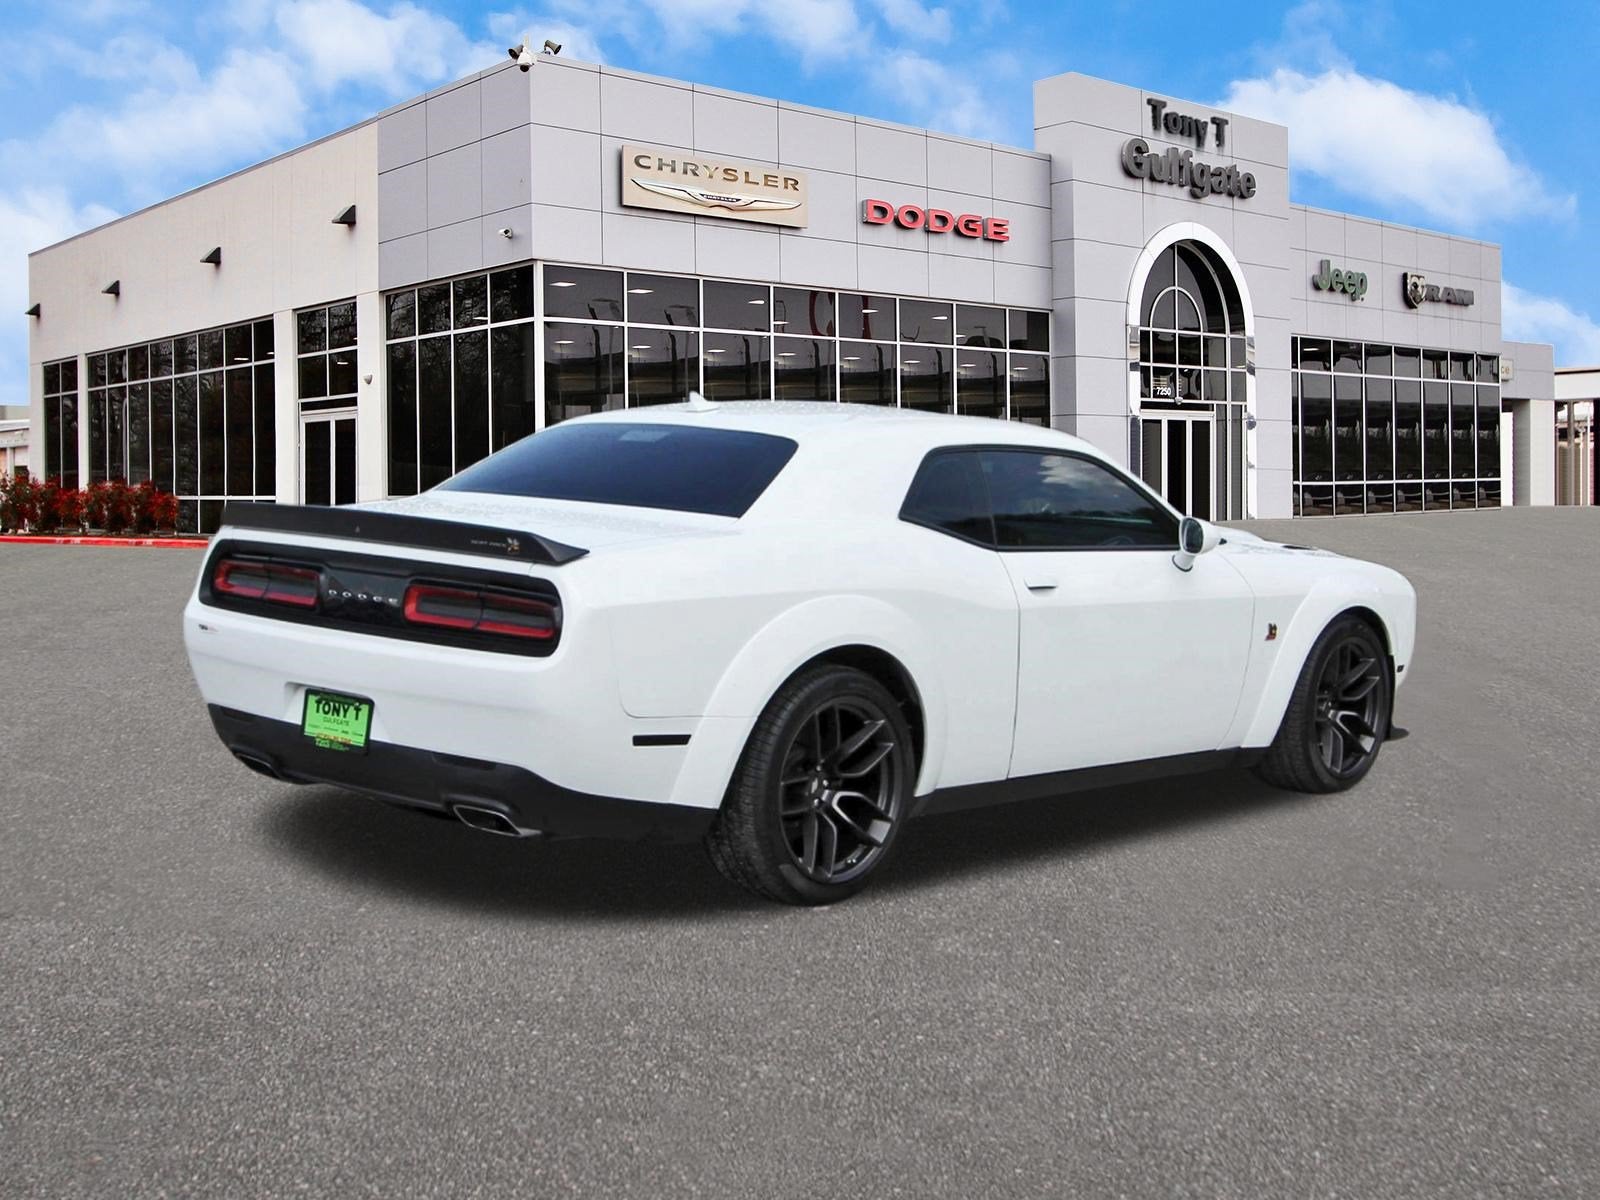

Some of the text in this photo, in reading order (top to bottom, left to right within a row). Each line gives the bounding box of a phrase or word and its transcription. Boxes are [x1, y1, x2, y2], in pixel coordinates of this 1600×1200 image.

[1147, 98, 1229, 148] Tony T
[634, 154, 800, 191] CHRYSLER
[1122, 137, 1256, 199] Gulfgate
[862, 198, 1010, 242] DODGE
[1312, 259, 1368, 302] Jeep
[1424, 283, 1475, 307] RAM
[1156, 386, 1172, 396] 7250
[328, 589, 399, 607] DODGE
[315, 699, 362, 721] TONY T
